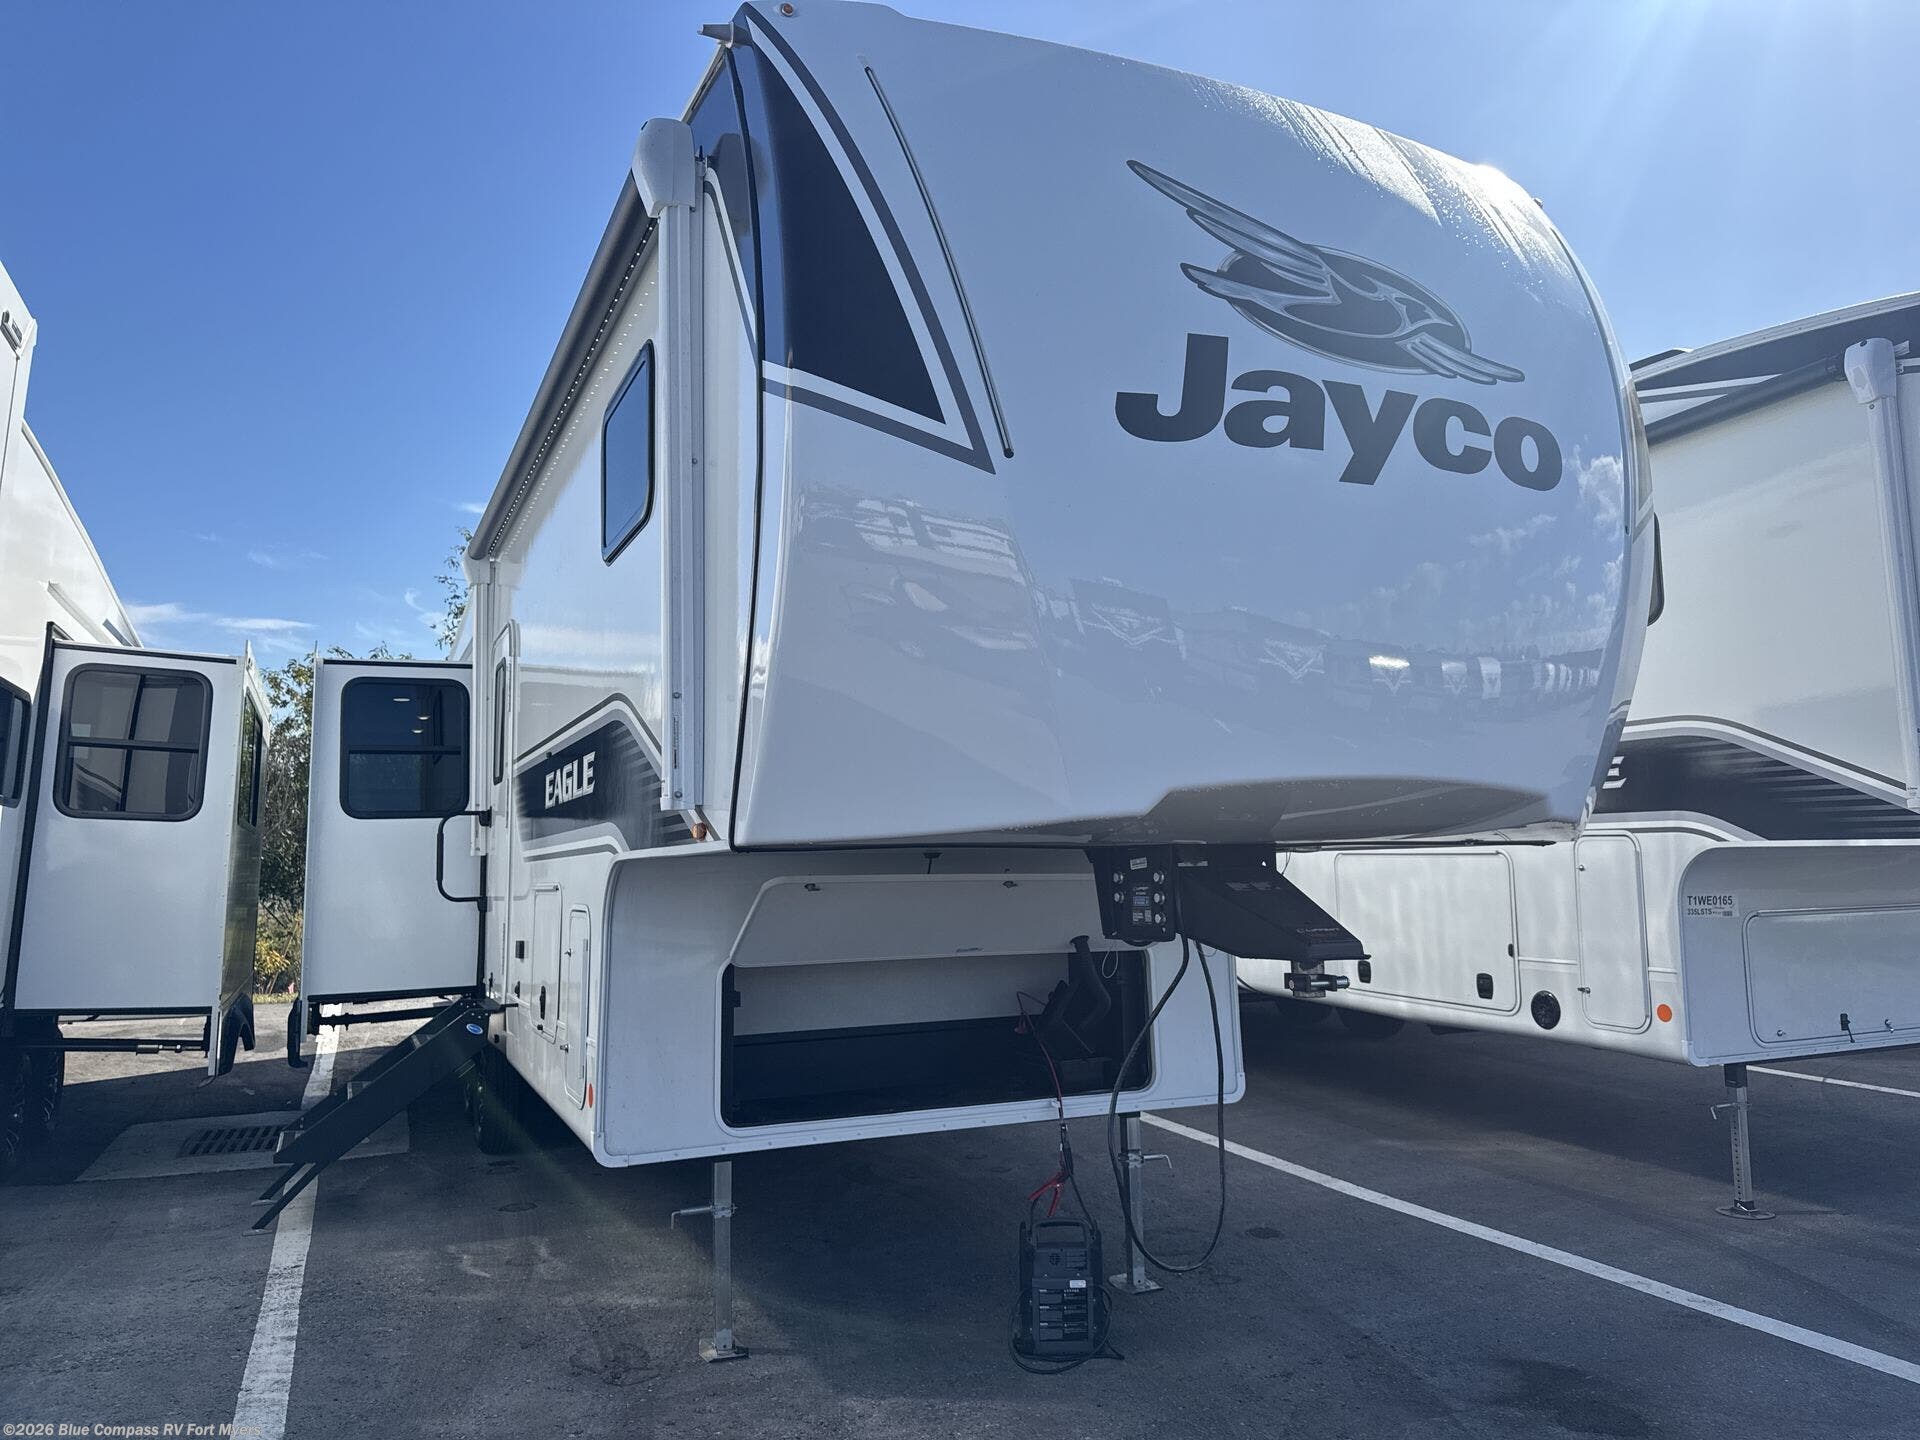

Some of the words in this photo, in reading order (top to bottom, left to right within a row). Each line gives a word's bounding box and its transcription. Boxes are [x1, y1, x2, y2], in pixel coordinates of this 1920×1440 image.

[1115, 333, 1562, 491] Jayco
[545, 752, 595, 809] EAGLE
[1687, 896, 1733, 906] T1WE0165
